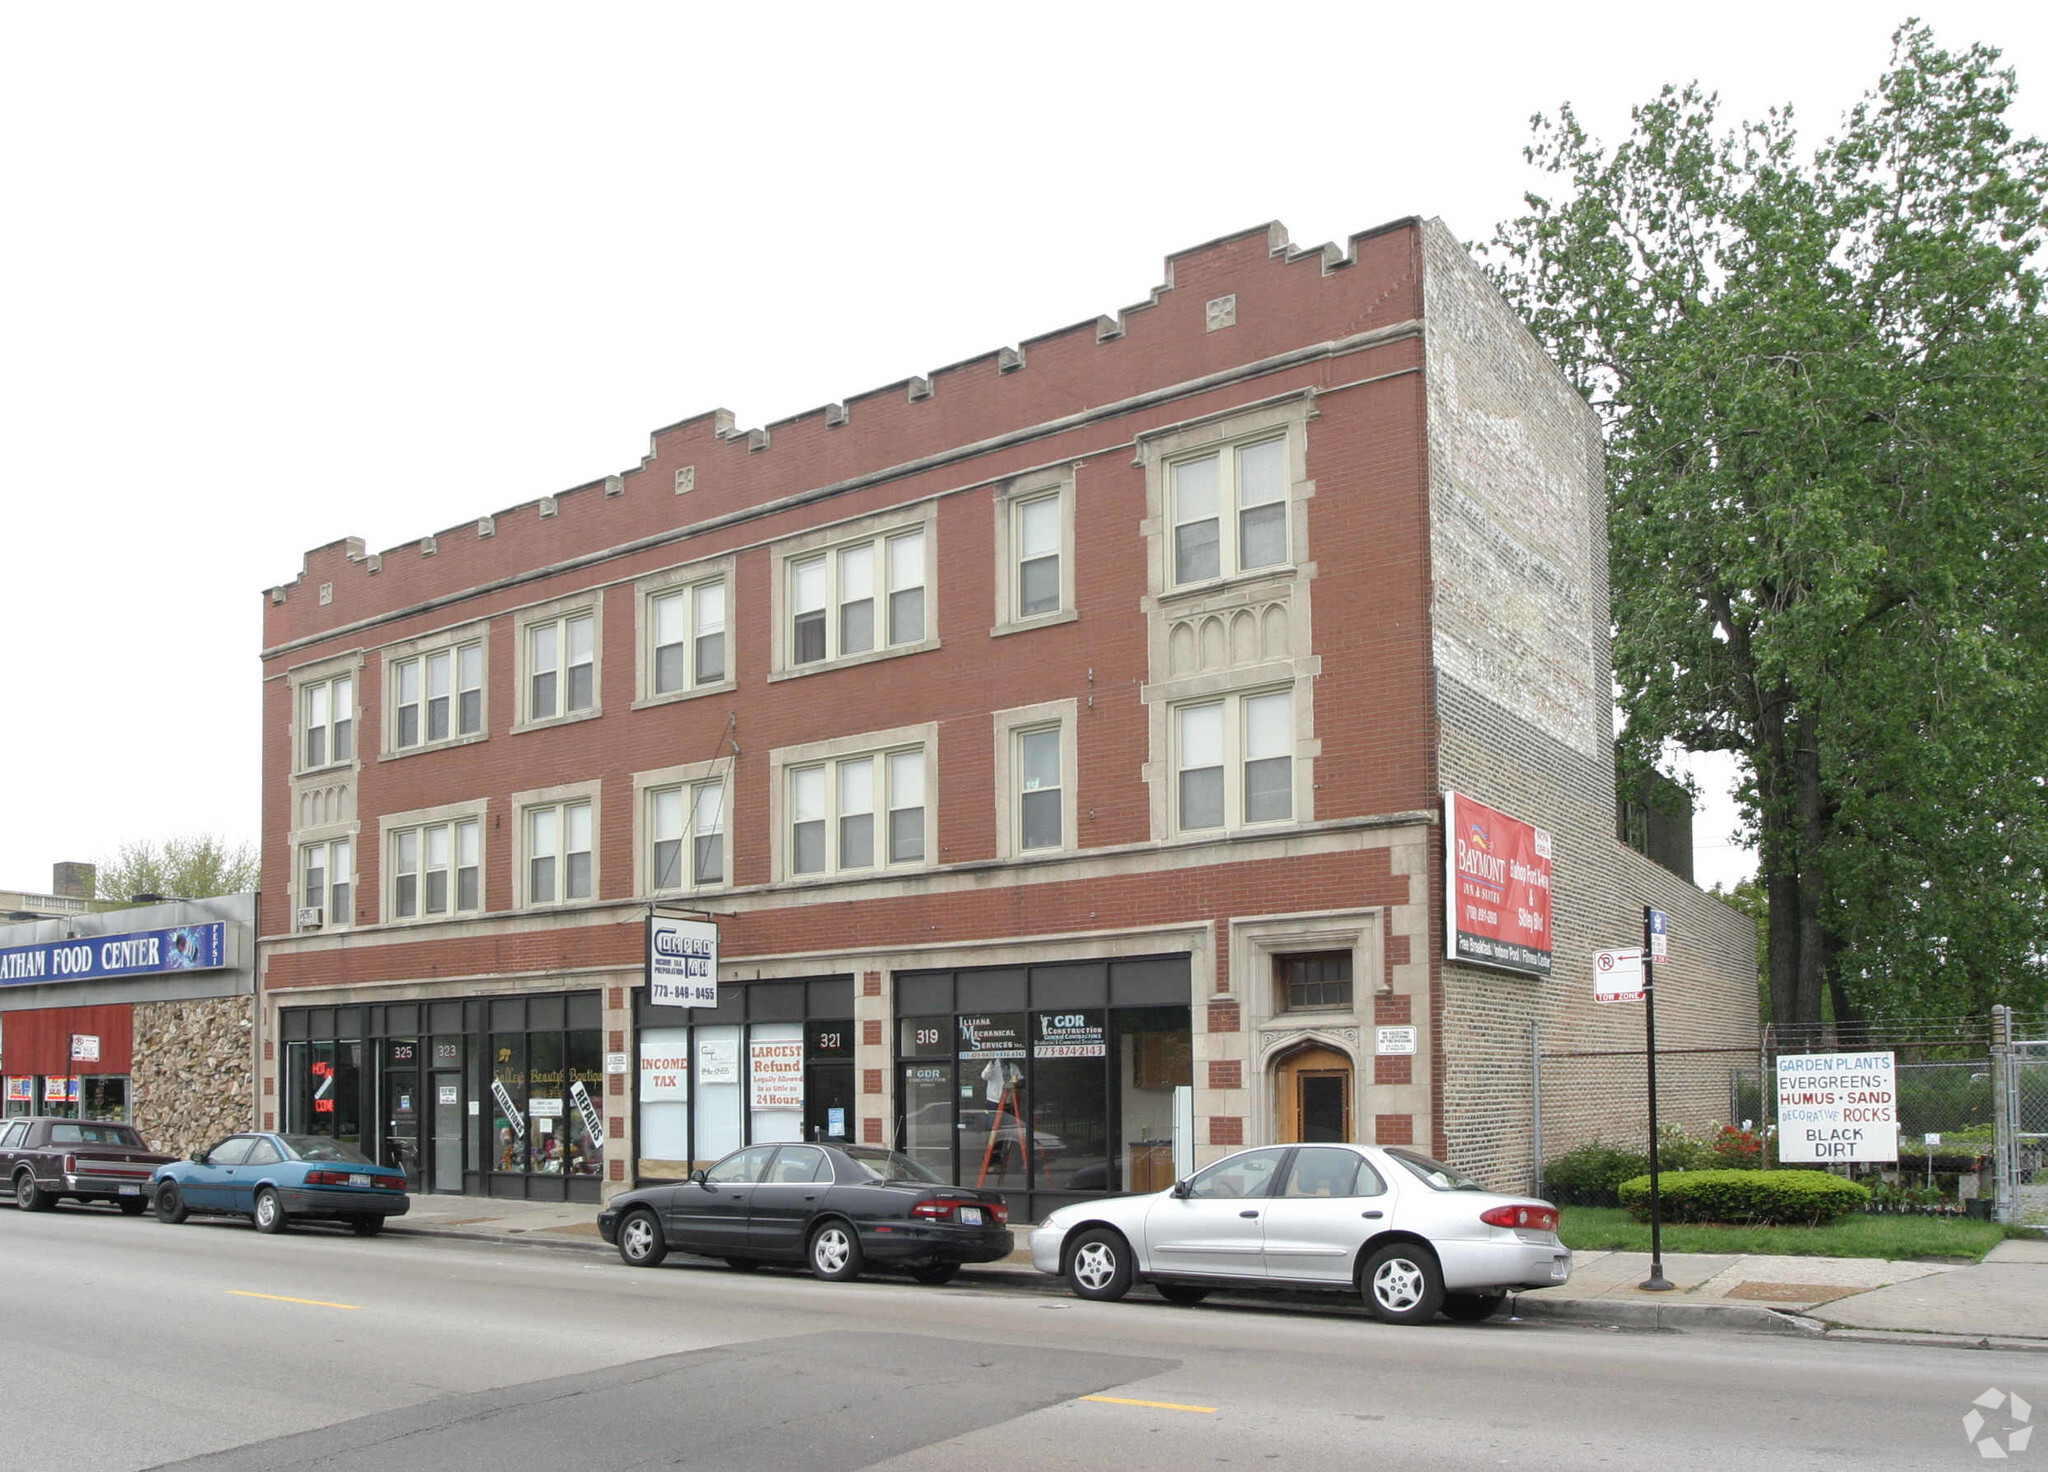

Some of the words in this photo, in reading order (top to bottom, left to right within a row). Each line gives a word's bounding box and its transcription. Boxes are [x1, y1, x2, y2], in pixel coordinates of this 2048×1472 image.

[1458, 839, 1506, 884] BAYMONT
[0, 950, 46, 980] ATHAM
[53, 945, 92, 975] FOOD
[102, 937, 160, 970] CENTER
[1619, 992, 1640, 1000] ZONE
[1054, 1015, 1085, 1027] GDR
[916, 1029, 939, 1044] 319
[962, 1026, 1016, 1040] MECHANICAL
[820, 1033, 841, 1047] 321
[395, 1046, 413, 1059] 325
[438, 1045, 456, 1057] 323
[751, 1046, 802, 1058] LARGEST
[642, 1058, 688, 1070] INCOME
[754, 1060, 800, 1072] Refund
[1779, 1058, 1833, 1072] GARDEN
[1836, 1056, 1891, 1071] PLANTS
[569, 1067, 603, 1089] Boutiqu
[754, 1076, 776, 1084] Legally
[917, 1069, 941, 1078] GDR
[653, 1076, 677, 1087] TAX
[1780, 1075, 1881, 1090] EVERGREENS
[756, 1095, 768, 1104] 24
[769, 1095, 800, 1104] Hours
[1780, 1093, 1835, 1105] HUMUS
[1847, 1092, 1892, 1104] SAND
[493, 1084, 525, 1135] ALTERATIONS
[575, 1089, 603, 1141] REPAIRS
[1782, 1109, 1840, 1123] DECORATIVE
[1844, 1108, 1891, 1122] ROCKS
[1806, 1128, 1864, 1141] BLACK
[1815, 1143, 1857, 1157] DIRT
